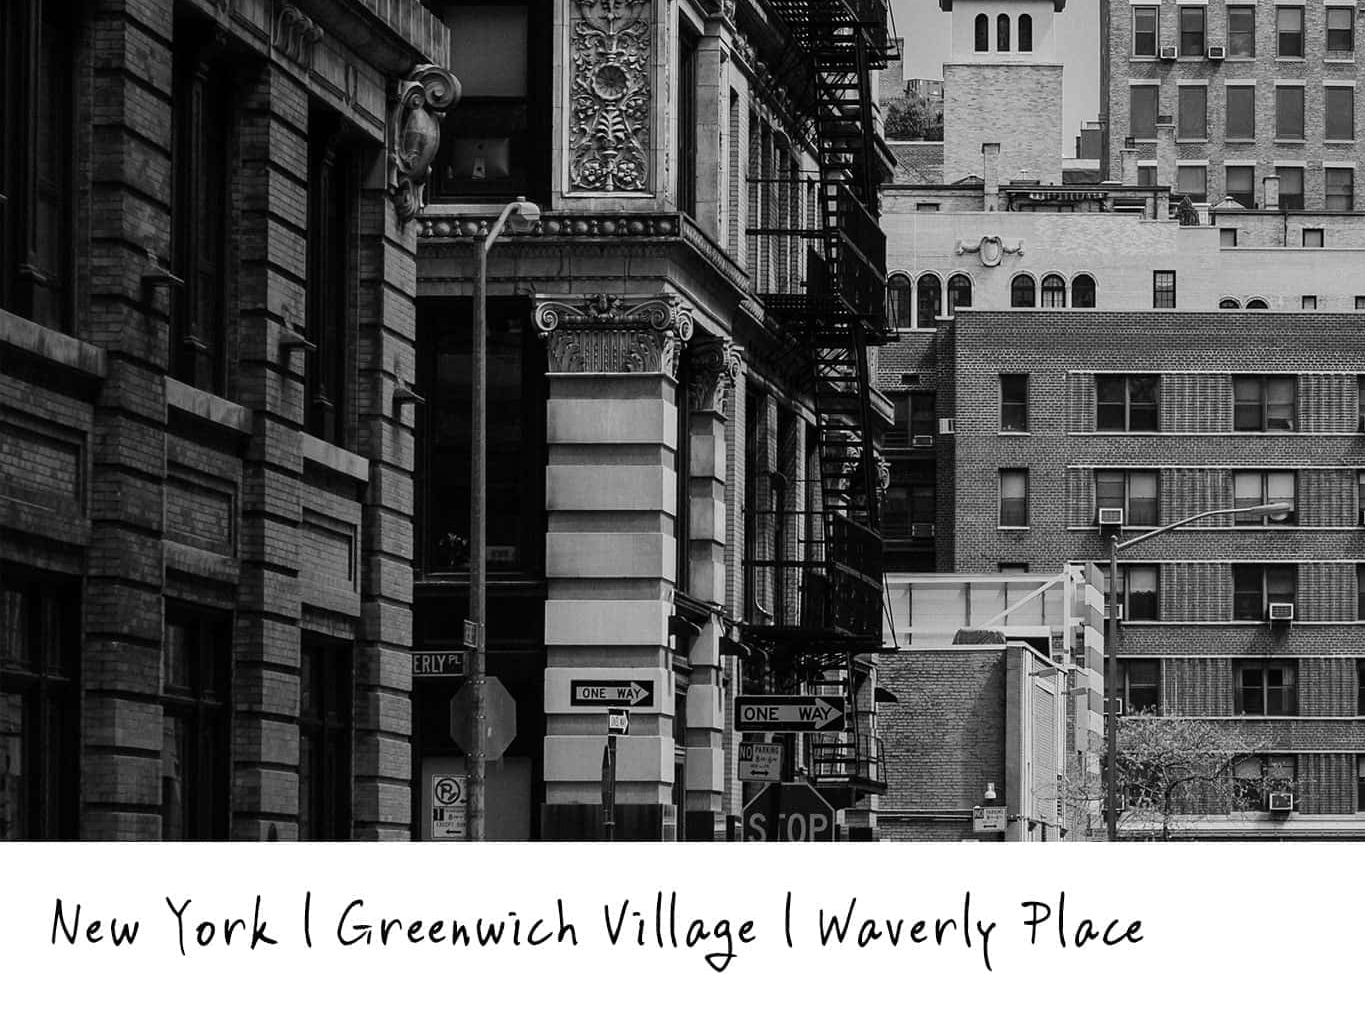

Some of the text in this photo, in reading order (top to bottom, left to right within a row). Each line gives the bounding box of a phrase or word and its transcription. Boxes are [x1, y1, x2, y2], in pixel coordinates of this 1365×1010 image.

[448, 654, 462, 668] PL
[583, 688, 641, 699] ONE WAY
[744, 707, 832, 721] ONE WAY
[740, 746, 753, 759] NO
